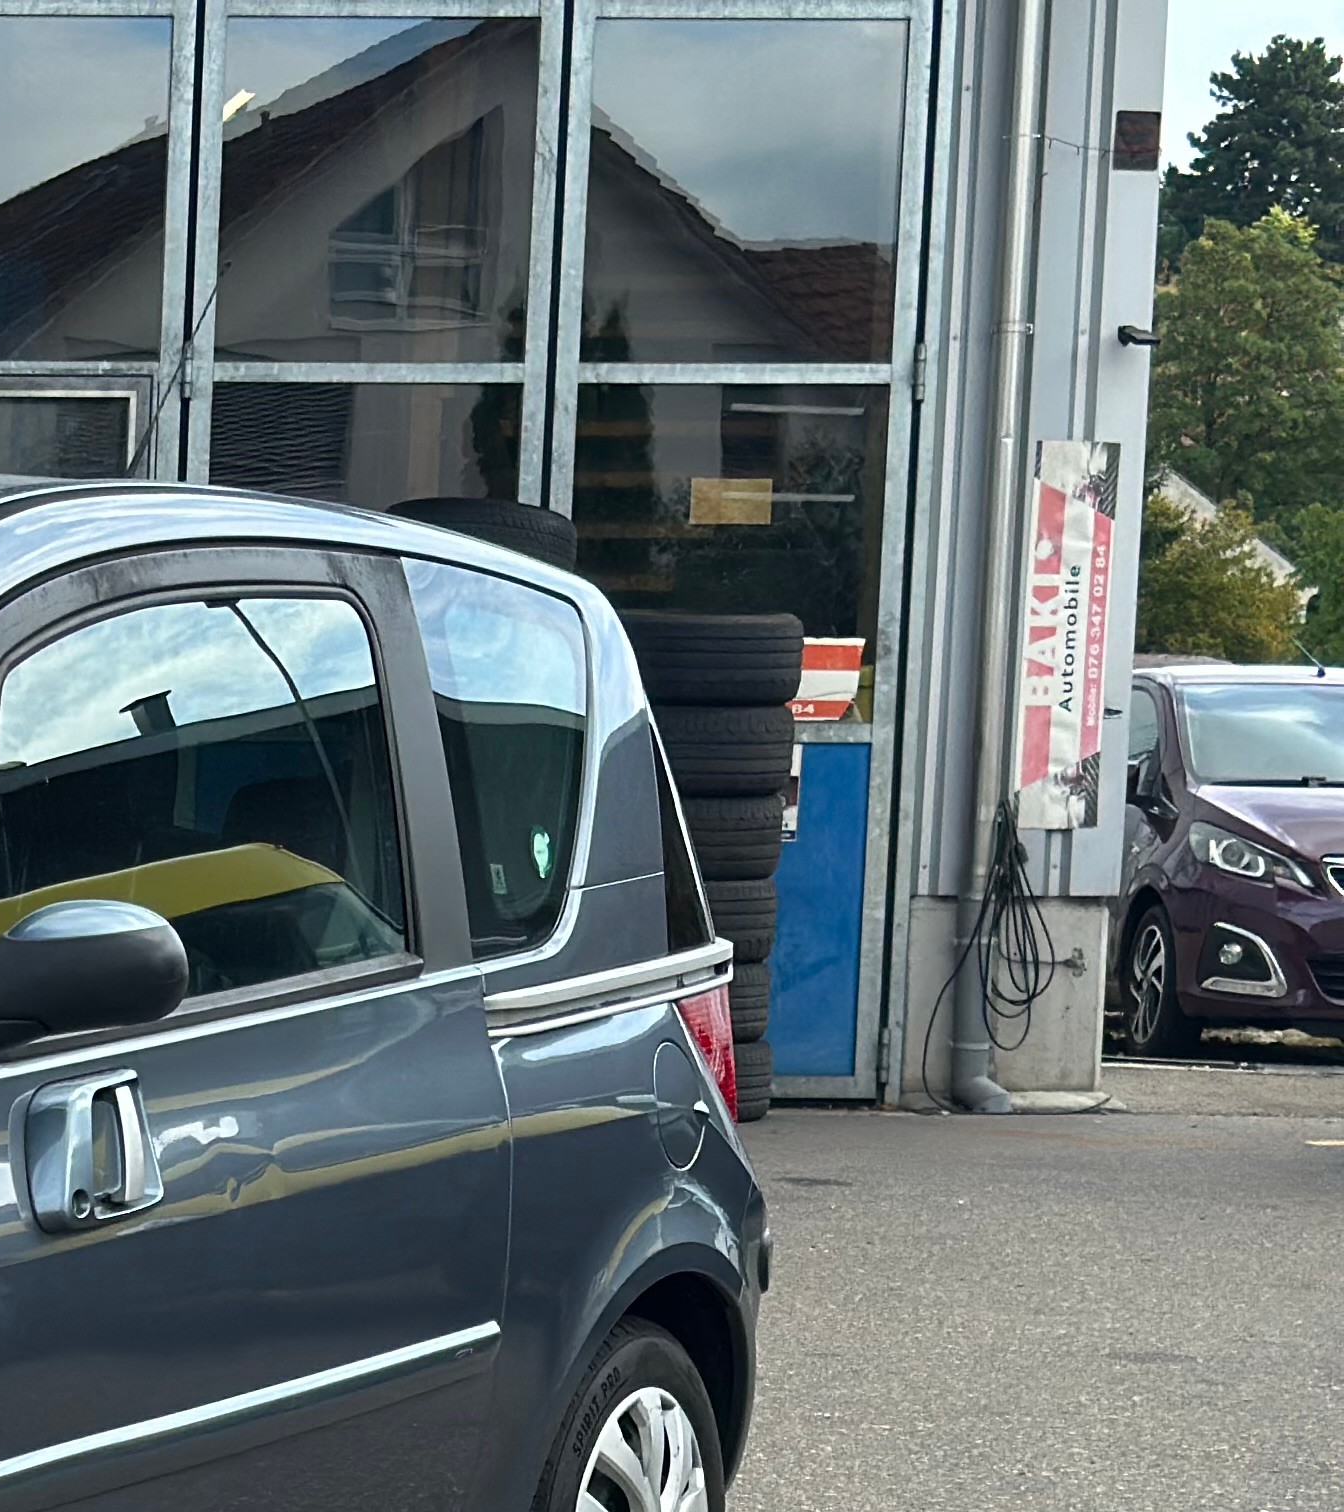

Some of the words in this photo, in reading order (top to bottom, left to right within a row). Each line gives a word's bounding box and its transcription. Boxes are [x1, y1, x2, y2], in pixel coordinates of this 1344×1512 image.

[1095, 545, 1106, 569] 84
[1093, 574, 1104, 597] 02
[1025, 573, 1061, 705] BAKI
[1057, 564, 1081, 713] Automobile
[1090, 603, 1102, 640] 347
[1088, 643, 1100, 679] 076
[1086, 684, 1098, 727] Mobile:
[572, 1395, 600, 1459] SPIRIT
